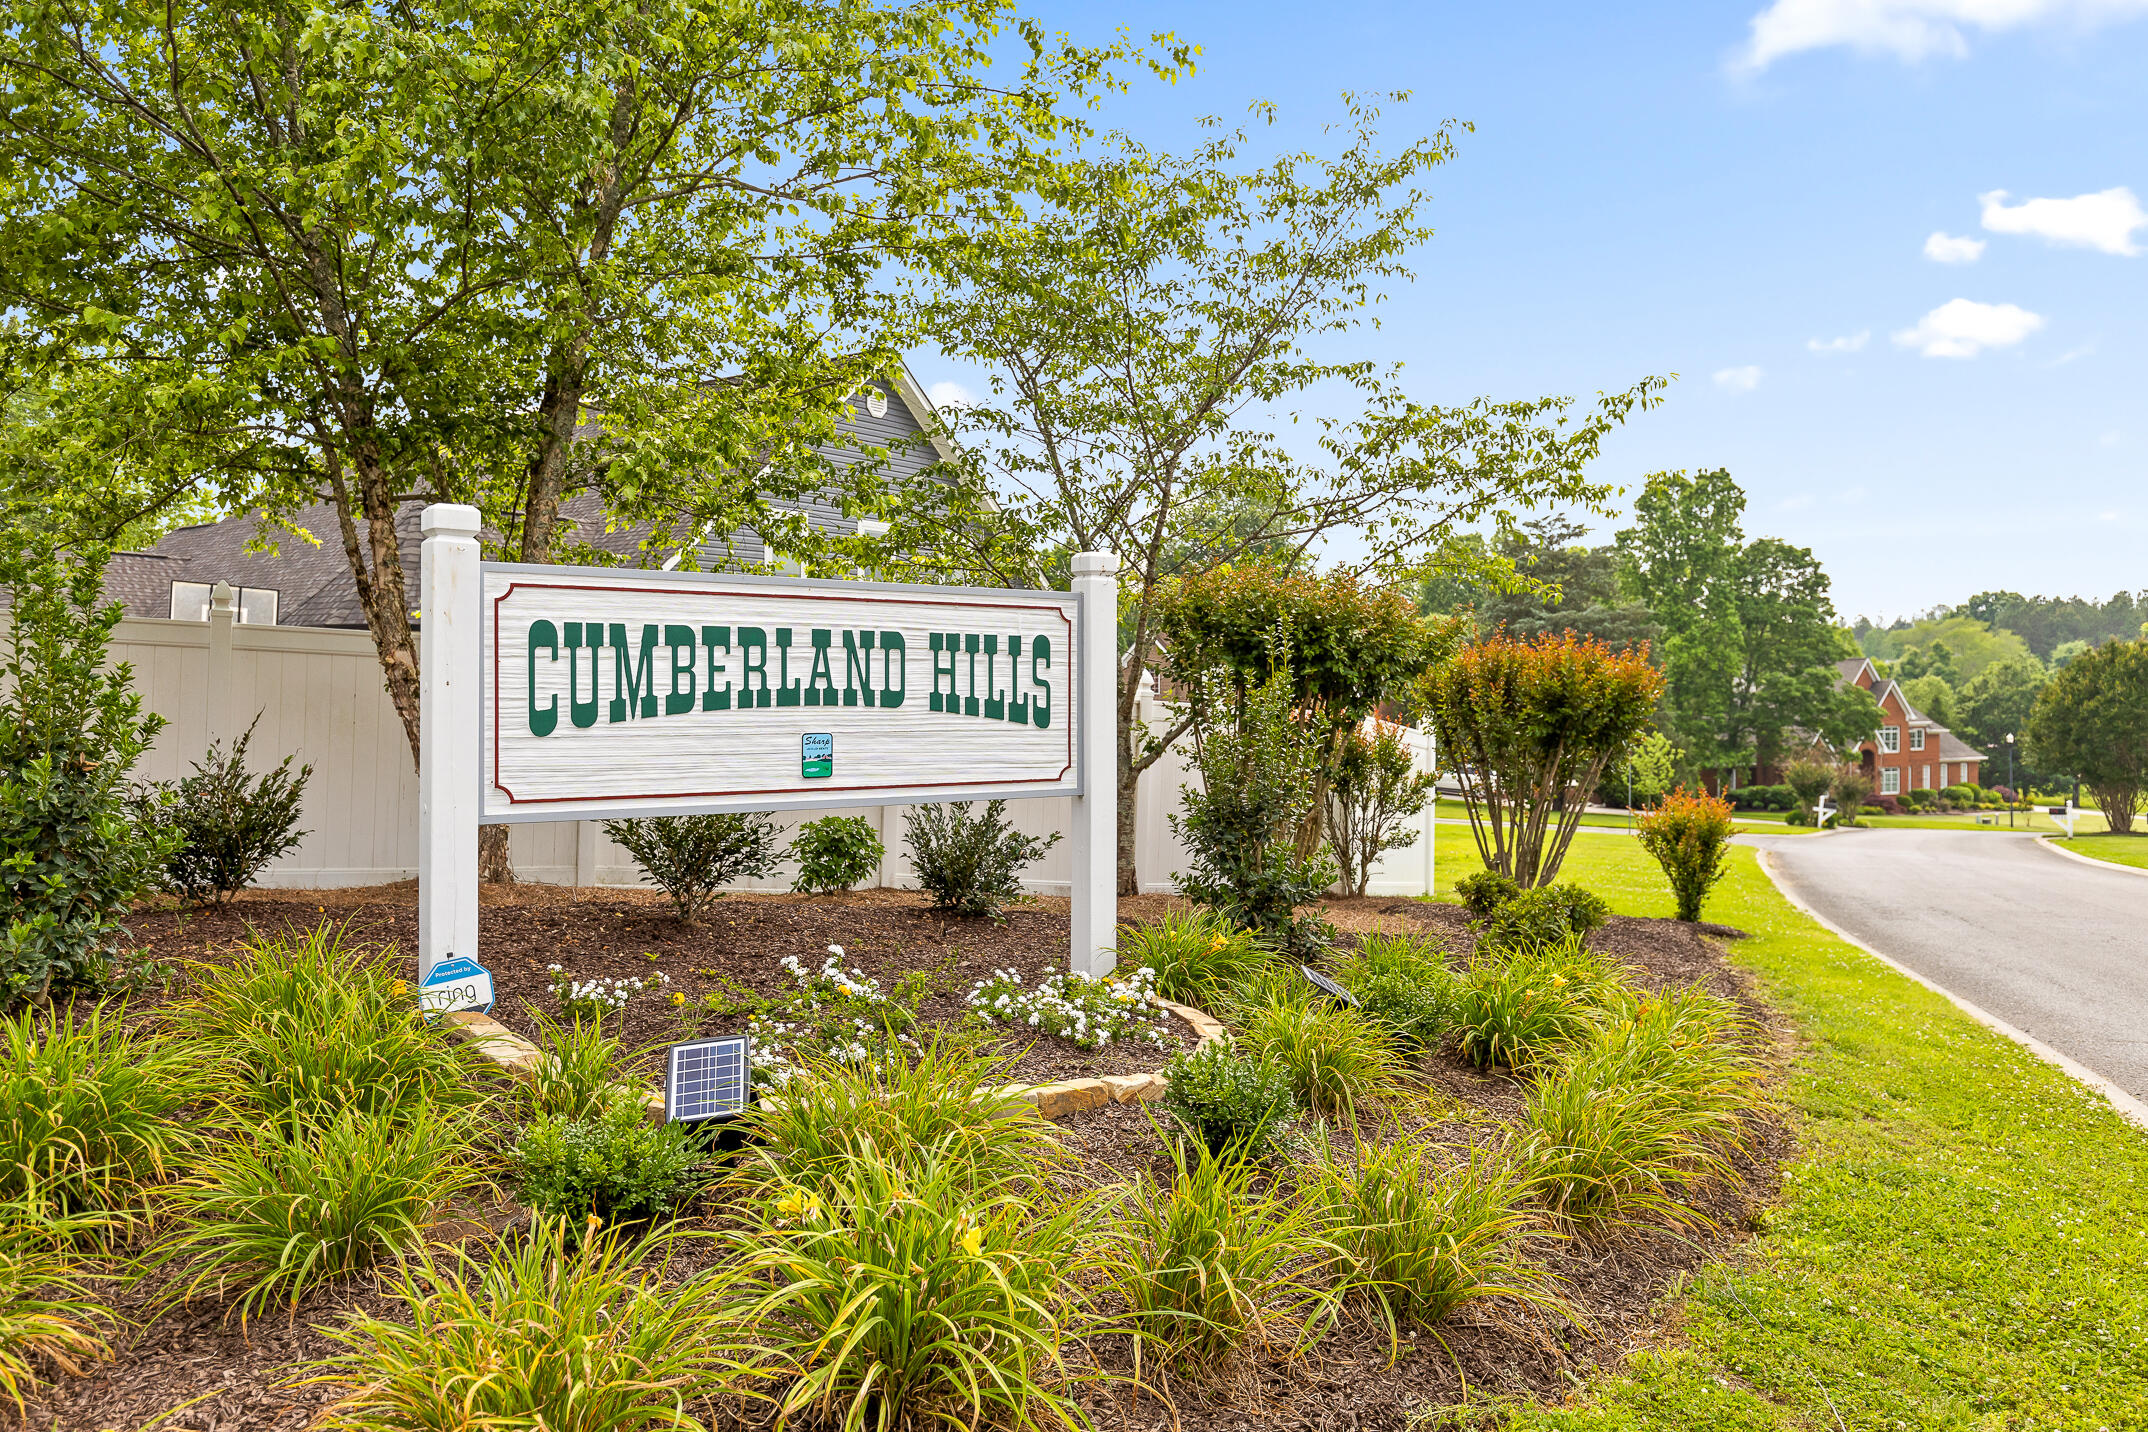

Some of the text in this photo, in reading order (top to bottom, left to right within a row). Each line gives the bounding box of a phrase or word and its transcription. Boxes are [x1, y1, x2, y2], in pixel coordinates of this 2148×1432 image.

[528, 619, 1051, 737] CUMBERLAND HILLS
[805, 736, 830, 746] Sharp
[435, 968, 463, 978] Protected
[438, 985, 476, 1005] ring
